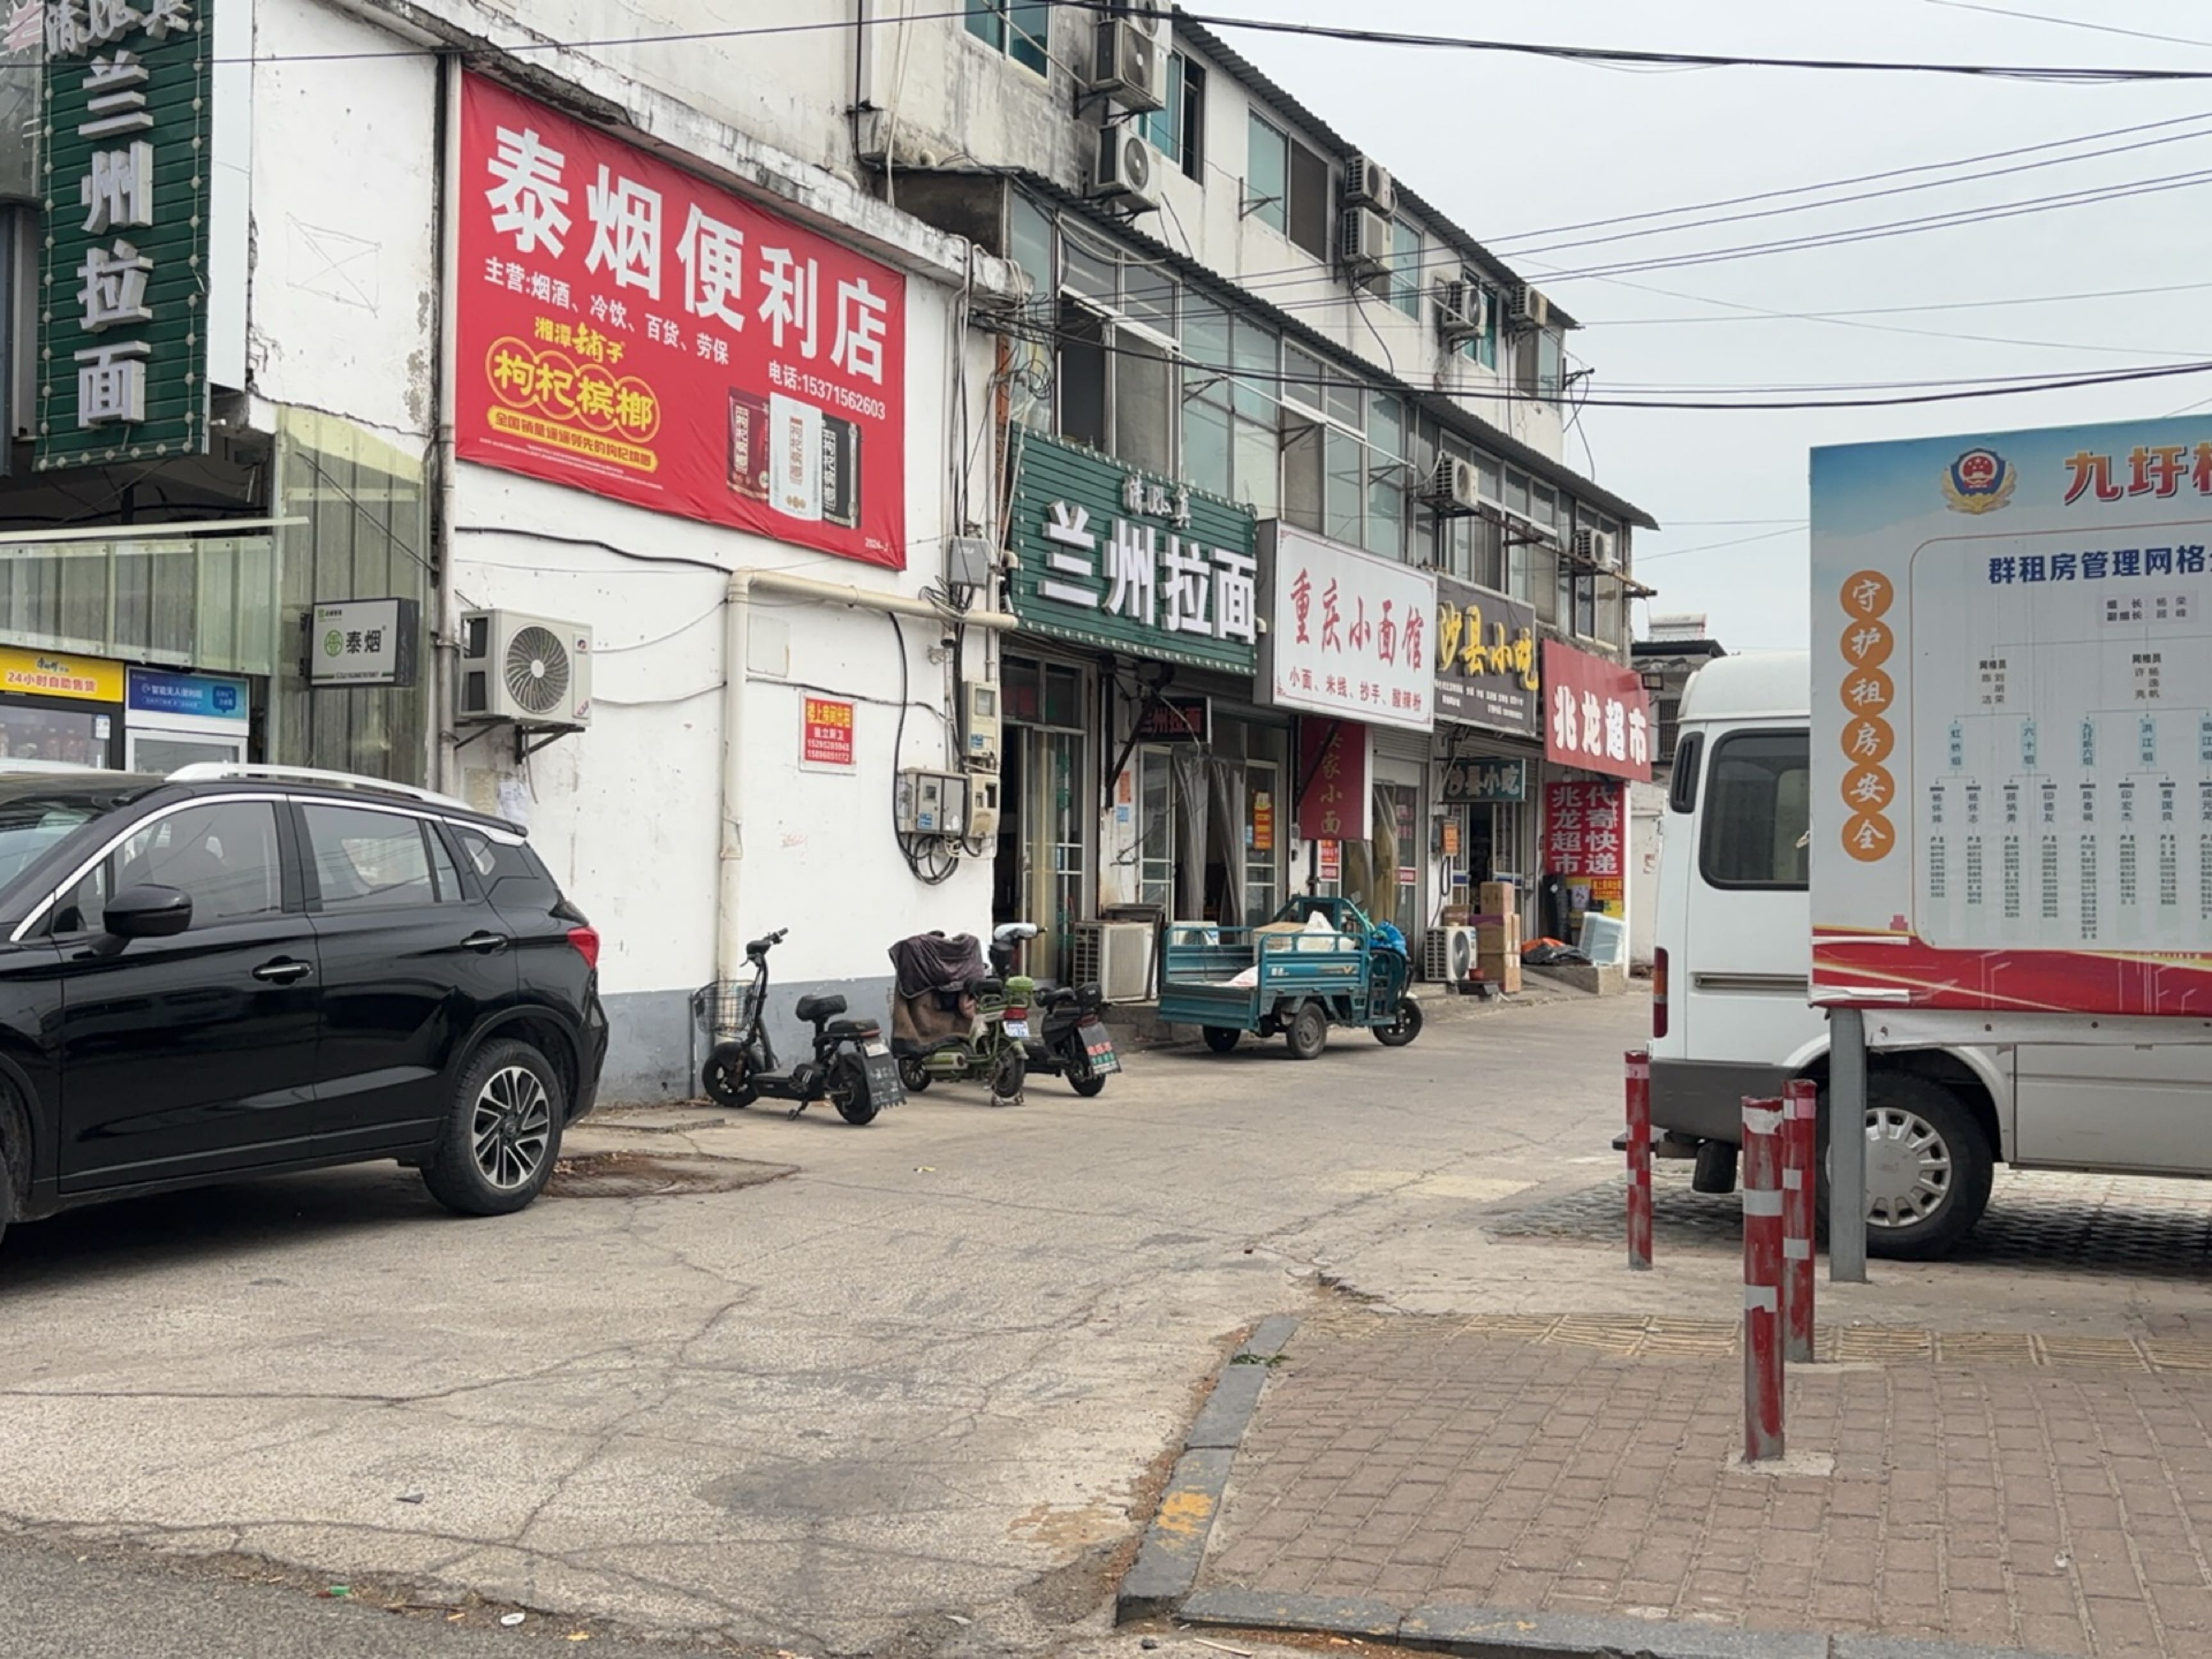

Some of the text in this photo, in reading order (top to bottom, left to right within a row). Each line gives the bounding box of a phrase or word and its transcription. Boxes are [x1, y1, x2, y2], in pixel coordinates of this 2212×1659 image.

[75, 50, 154, 429] 兰州拉面
[485, 126, 887, 385] 泰烟便利店
[494, 349, 653, 431] 枸杞槟榔
[768, 360, 886, 420] 电话:15371562603
[1038, 500, 1256, 645] 兰州拉面
[1989, 544, 2212, 584] 群租房管理网格
[346, 630, 382, 654] 泰烟
[1290, 567, 1425, 673] 重庆小面馆
[1436, 600, 1539, 690] 沙县小吃
[8, 672, 96, 692] 24小时自助售货
[1551, 685, 1648, 767] 兆龙超市
[1849, 579, 1886, 849] 守护租房安全
[1447, 764, 1519, 796] 沙县小吃
[1551, 786, 1582, 875] 兆龙超市
[1585, 786, 1619, 875] 代寄快递
